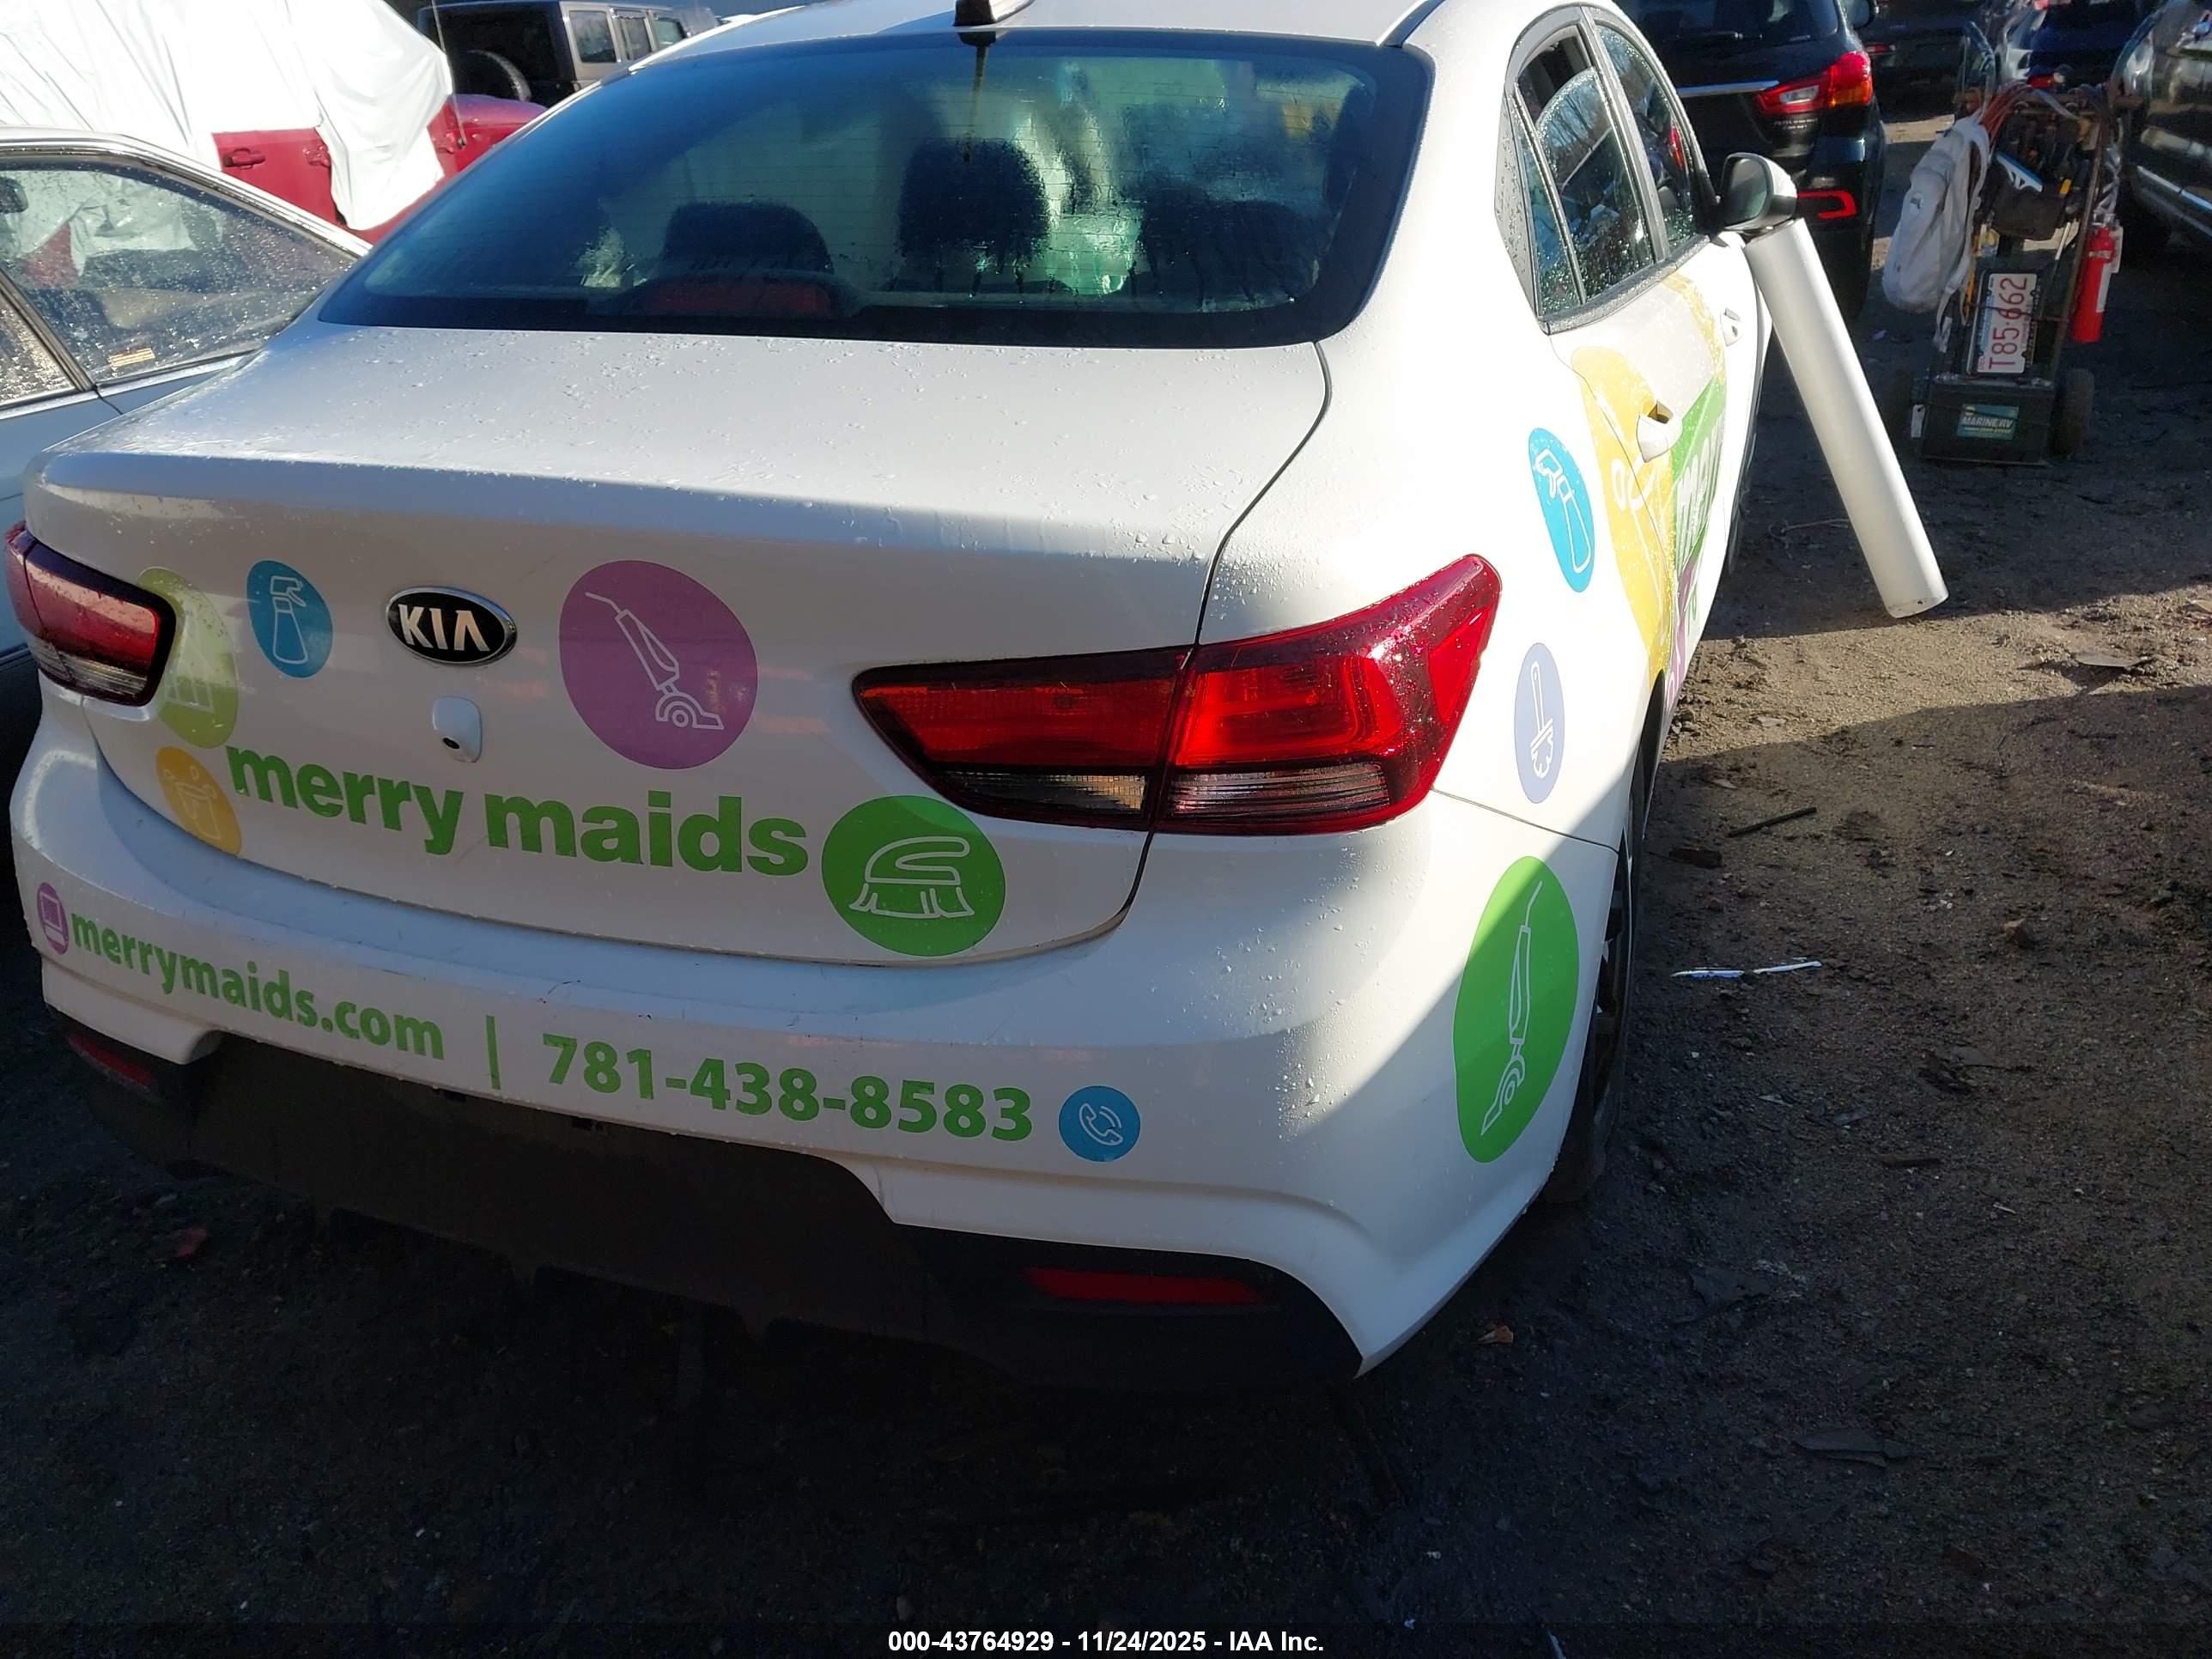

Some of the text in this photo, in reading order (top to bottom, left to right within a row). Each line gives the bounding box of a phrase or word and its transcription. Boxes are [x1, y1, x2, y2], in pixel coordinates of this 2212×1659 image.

[398, 604, 490, 652] KIA
[226, 745, 809, 877] merry maids
[70, 913, 1033, 1142] merrymaids.com 781-438-8583
